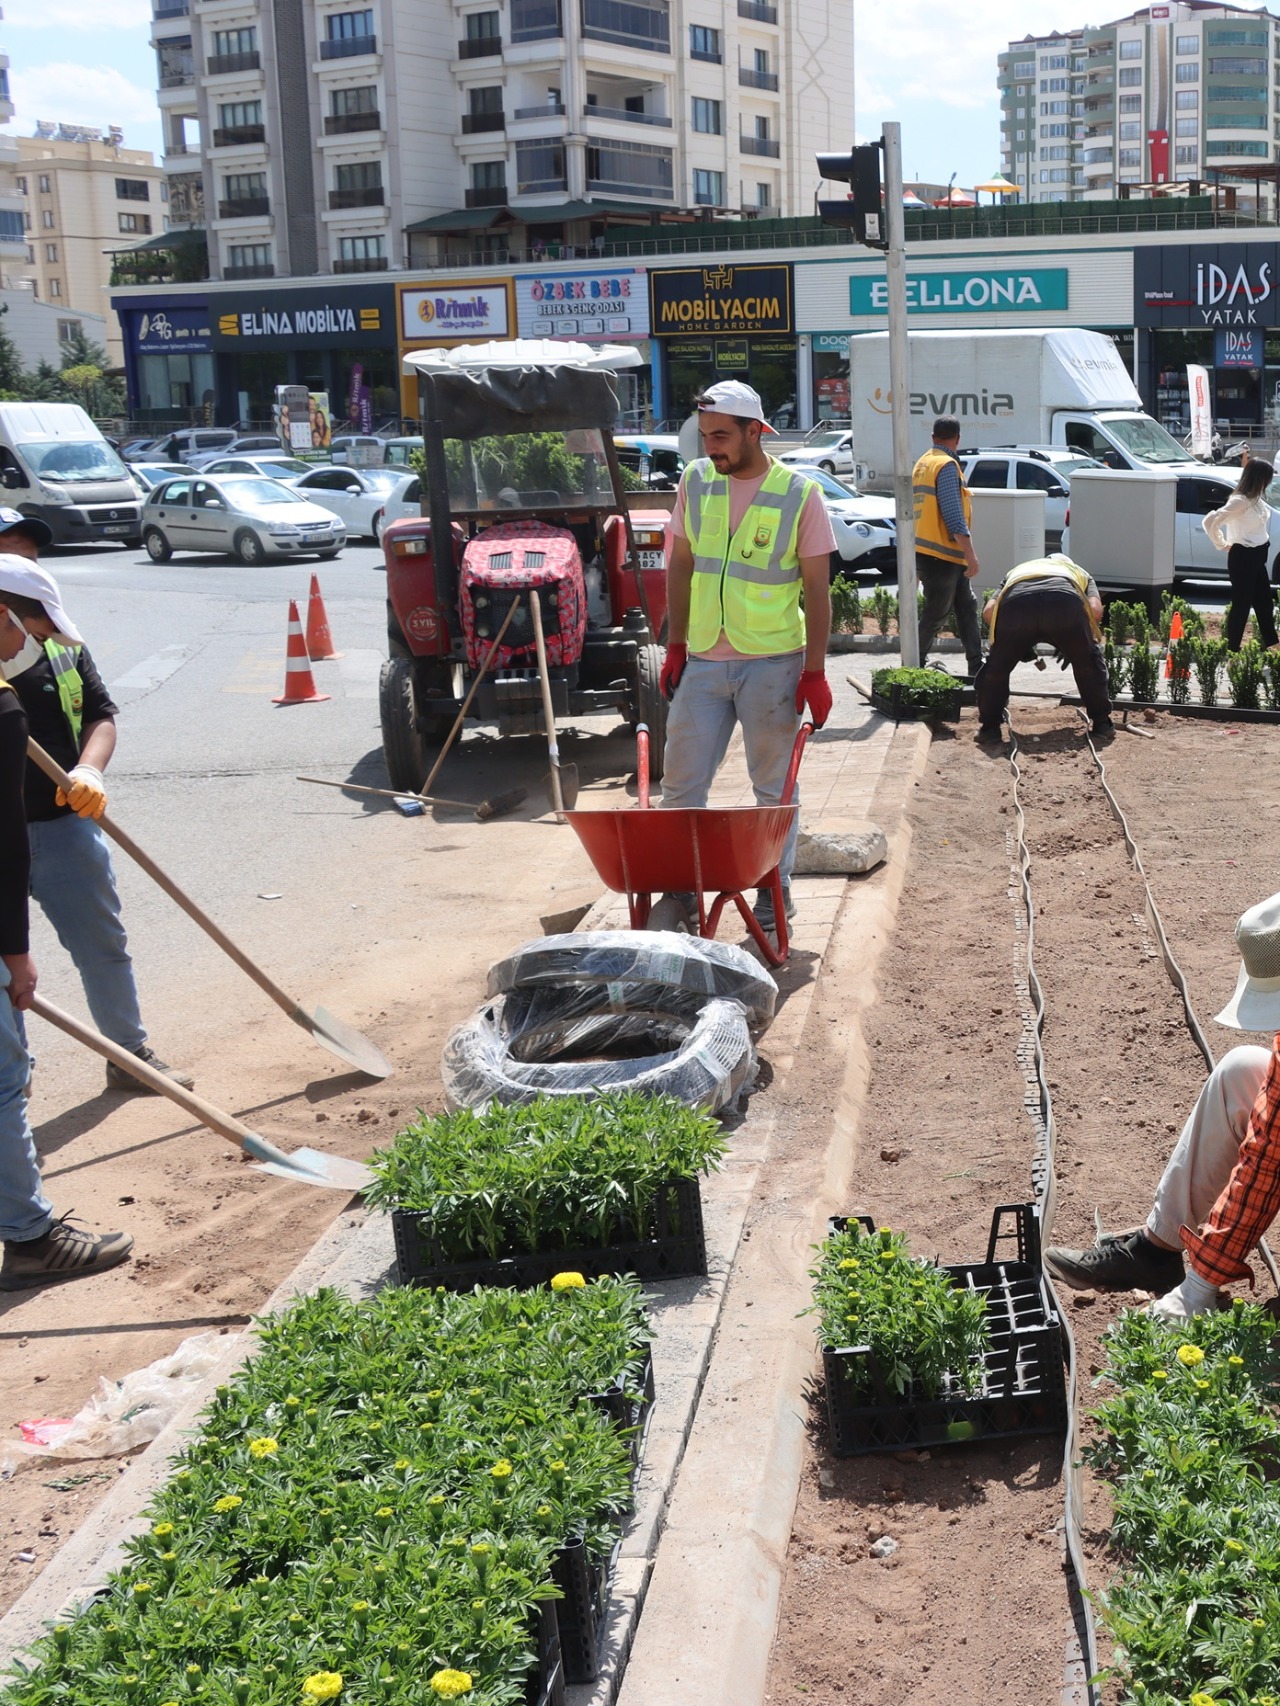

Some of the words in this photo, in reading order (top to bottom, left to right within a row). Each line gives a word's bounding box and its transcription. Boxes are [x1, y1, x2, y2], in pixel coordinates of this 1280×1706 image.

[531, 280, 585, 301] ÖZBEK
[590, 279, 631, 298] BEBE
[869, 277, 1042, 307] BELLONA
[435, 296, 488, 318] Ritmik
[537, 304, 564, 316] BEBEK
[571, 303, 596, 316] GENÇ
[661, 293, 780, 322] MOBİLYACIM
[241, 306, 293, 336] ELİNA
[295, 304, 356, 333] MOBİLYA
[1201, 310, 1257, 324] YATAK
[679, 323, 709, 331] HOME
[714, 322, 762, 330] GARDEN
[820, 336, 850, 346] DOQ
[718, 351, 746, 361] MOBİLYACIM
[909, 388, 1014, 416] evmia
[419, 619, 436, 627] YIL
